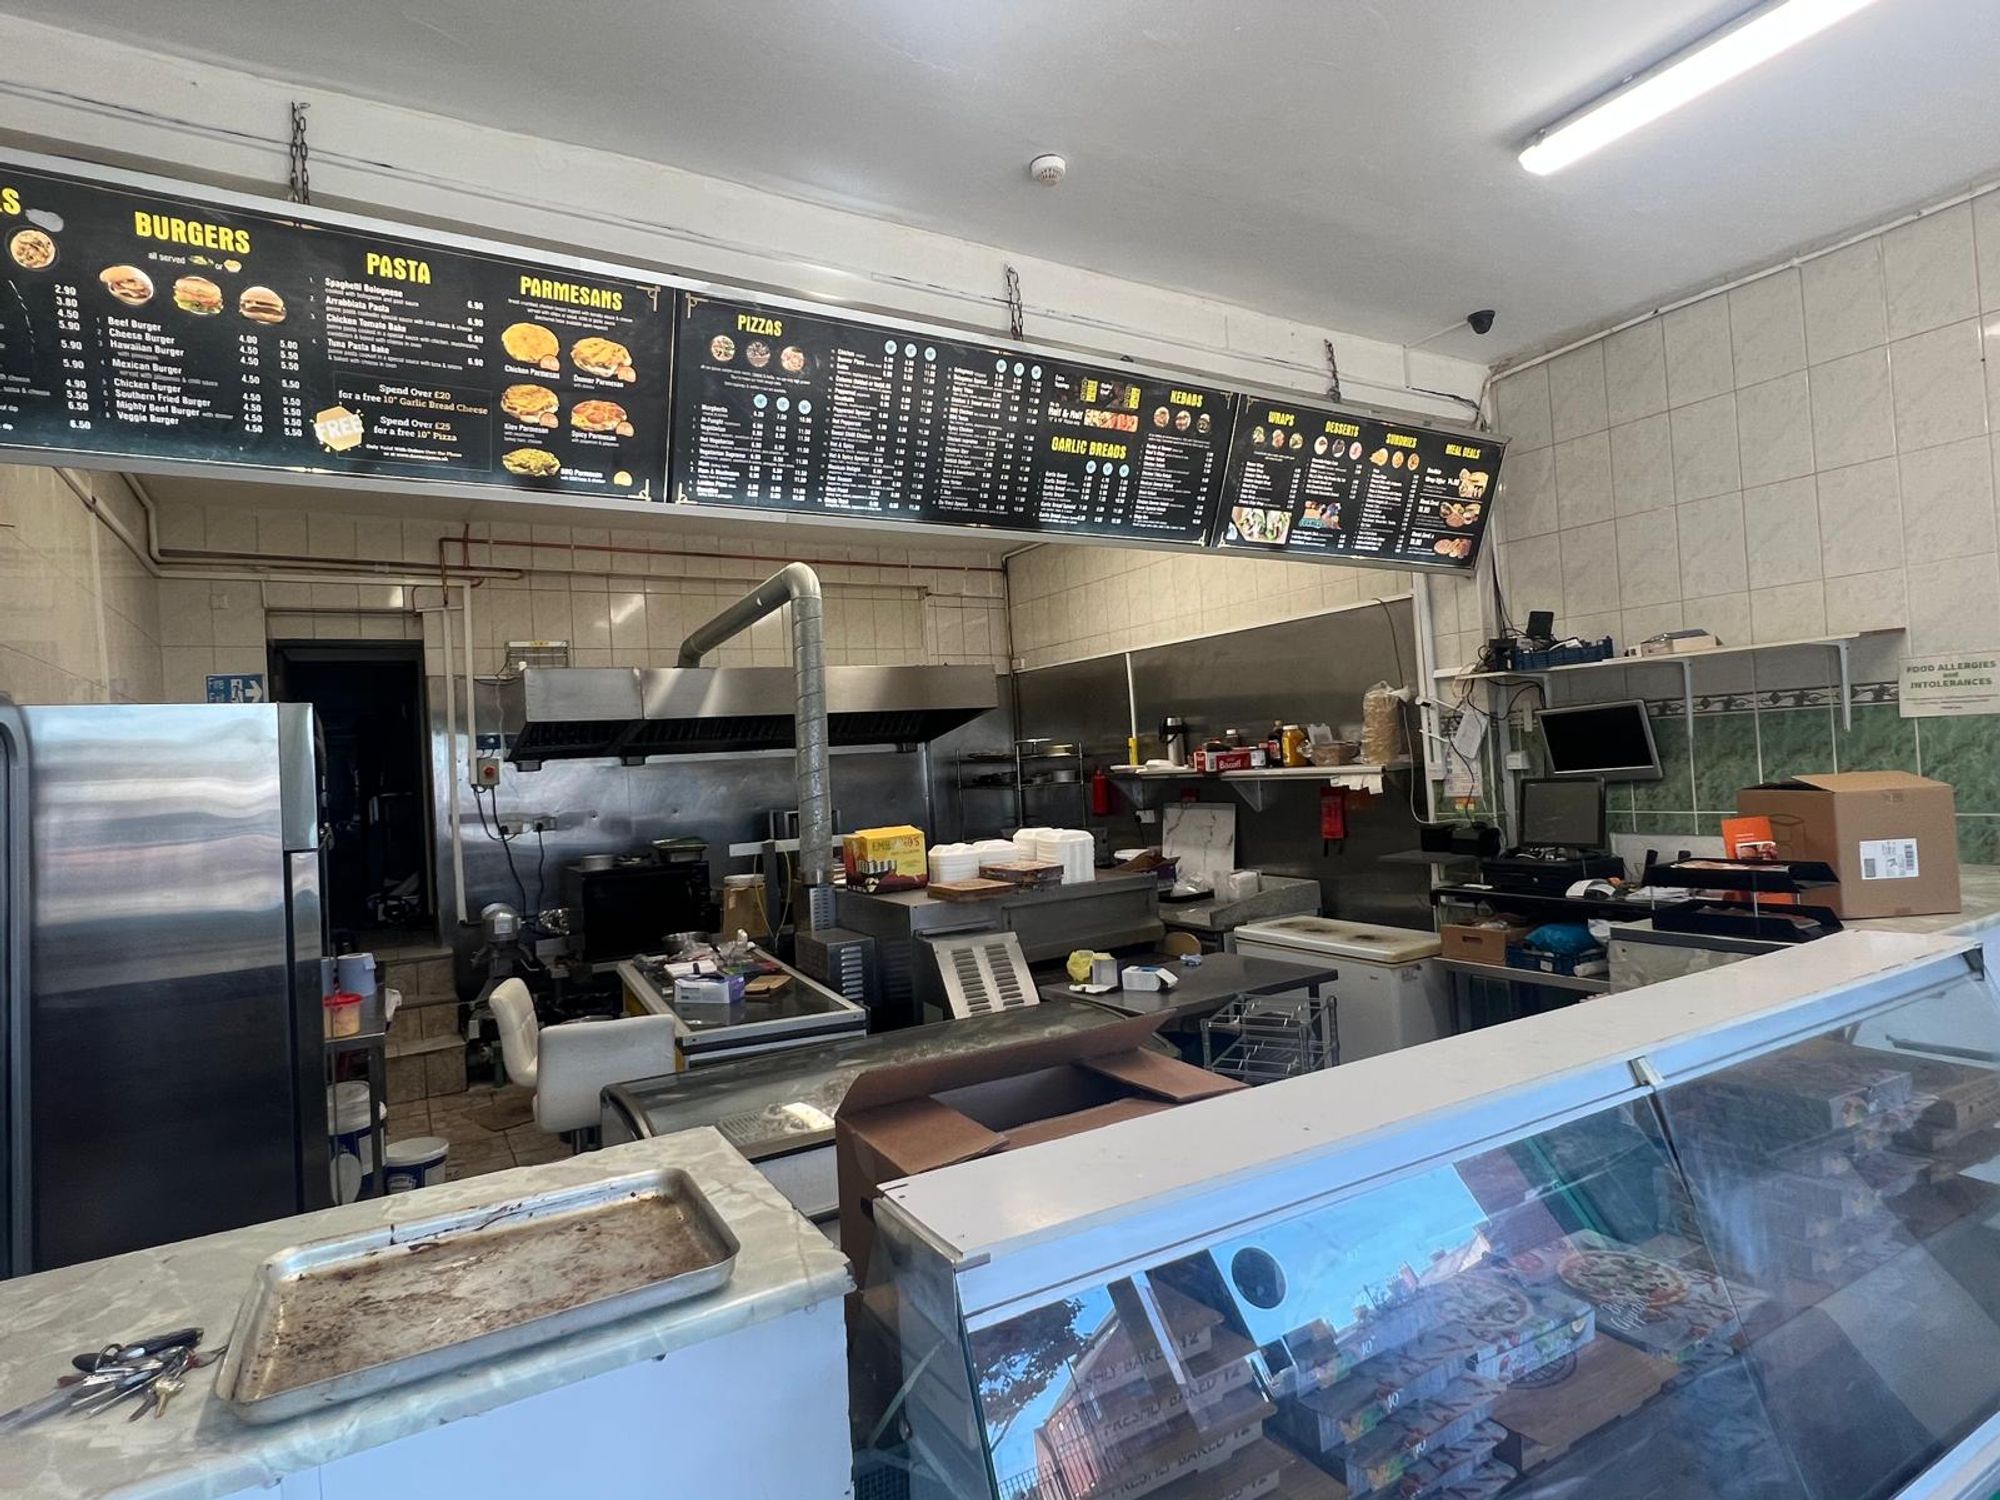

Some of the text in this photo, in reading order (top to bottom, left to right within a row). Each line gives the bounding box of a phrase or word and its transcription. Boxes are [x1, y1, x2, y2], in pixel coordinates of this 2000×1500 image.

[0, 187, 21, 215] S
[134, 211, 250, 254] BURGERS
[366, 251, 431, 285] PASTA
[54, 284, 77, 296] 2.90
[324, 277, 362, 291] Spaghetti
[363, 283, 403, 298] Bolognese
[520, 275, 623, 311] PARMESANS
[57, 308, 79, 319] 4.50
[368, 301, 390, 313] Pasta
[58, 320, 80, 331] 5.90
[107, 316, 162, 332] Beef Burger
[326, 314, 357, 326] Chicken
[359, 318, 386, 330] Tomato
[388, 322, 407, 333] Bake
[737, 313, 783, 338] PIZZAS
[108, 328, 143, 340] Cheese
[145, 333, 176, 345] Burger
[60, 339, 83, 350] 5.90
[110, 339, 152, 353] Hawaiian
[154, 344, 185, 357] Burger
[239, 345, 258, 355] 4.50
[327, 338, 390, 354] Tuna Pasta Bake
[240, 356, 259, 367] 4.50
[280, 351, 299, 361] 5.50
[62, 358, 85, 370] 5.90
[112, 358, 182, 375] Mexican Burger
[280, 361, 299, 371] 5.50
[504, 364, 560, 380] Chicken Parmesan
[113, 378, 150, 389] Chicken
[152, 382, 182, 394] Burger
[241, 374, 260, 385] 4.50
[281, 379, 300, 389] 5.50
[595, 378, 624, 388] Parmesan
[66, 390, 88, 400] 5.50
[115, 389, 211, 408] Southern Fried Burger
[243, 392, 261, 402] 4.50
[379, 384, 451, 400] Spend Over £20
[1170, 389, 1203, 408] KEBABS
[116, 400, 147, 414] Mighty
[149, 403, 169, 414] Beef
[170, 406, 200, 418] Burger
[243, 403, 262, 413] 4.50
[282, 397, 301, 407] 5.50
[338, 389, 353, 400] for
[362, 393, 382, 403] free
[399, 397, 427, 408] Garlic
[429, 401, 454, 412] Bread
[456, 404, 488, 415] Cheese
[117, 411, 179, 426] Veggie Burger
[244, 413, 263, 424] 4.50
[283, 407, 302, 417] 5.50
[1268, 410, 1295, 427] WRAPS
[245, 424, 263, 434] 4.50
[283, 418, 302, 428] 5.50
[379, 415, 451, 431] Spend Over £25
[518, 425, 549, 434] Parmesan
[1325, 420, 1360, 438] DESSERTS
[284, 428, 302, 438] 5.50
[374, 425, 388, 435] for
[397, 428, 416, 437] free
[433, 432, 458, 442] Pizza
[588, 432, 617, 441] Parmesan
[1051, 436, 1127, 460] GARLIC BREADS
[1906, 660, 1997, 674] FOOD ALLERGIES
[1910, 677, 1993, 689] INTOLERANCES
[1124, 1347, 1164, 1371] BAKE
